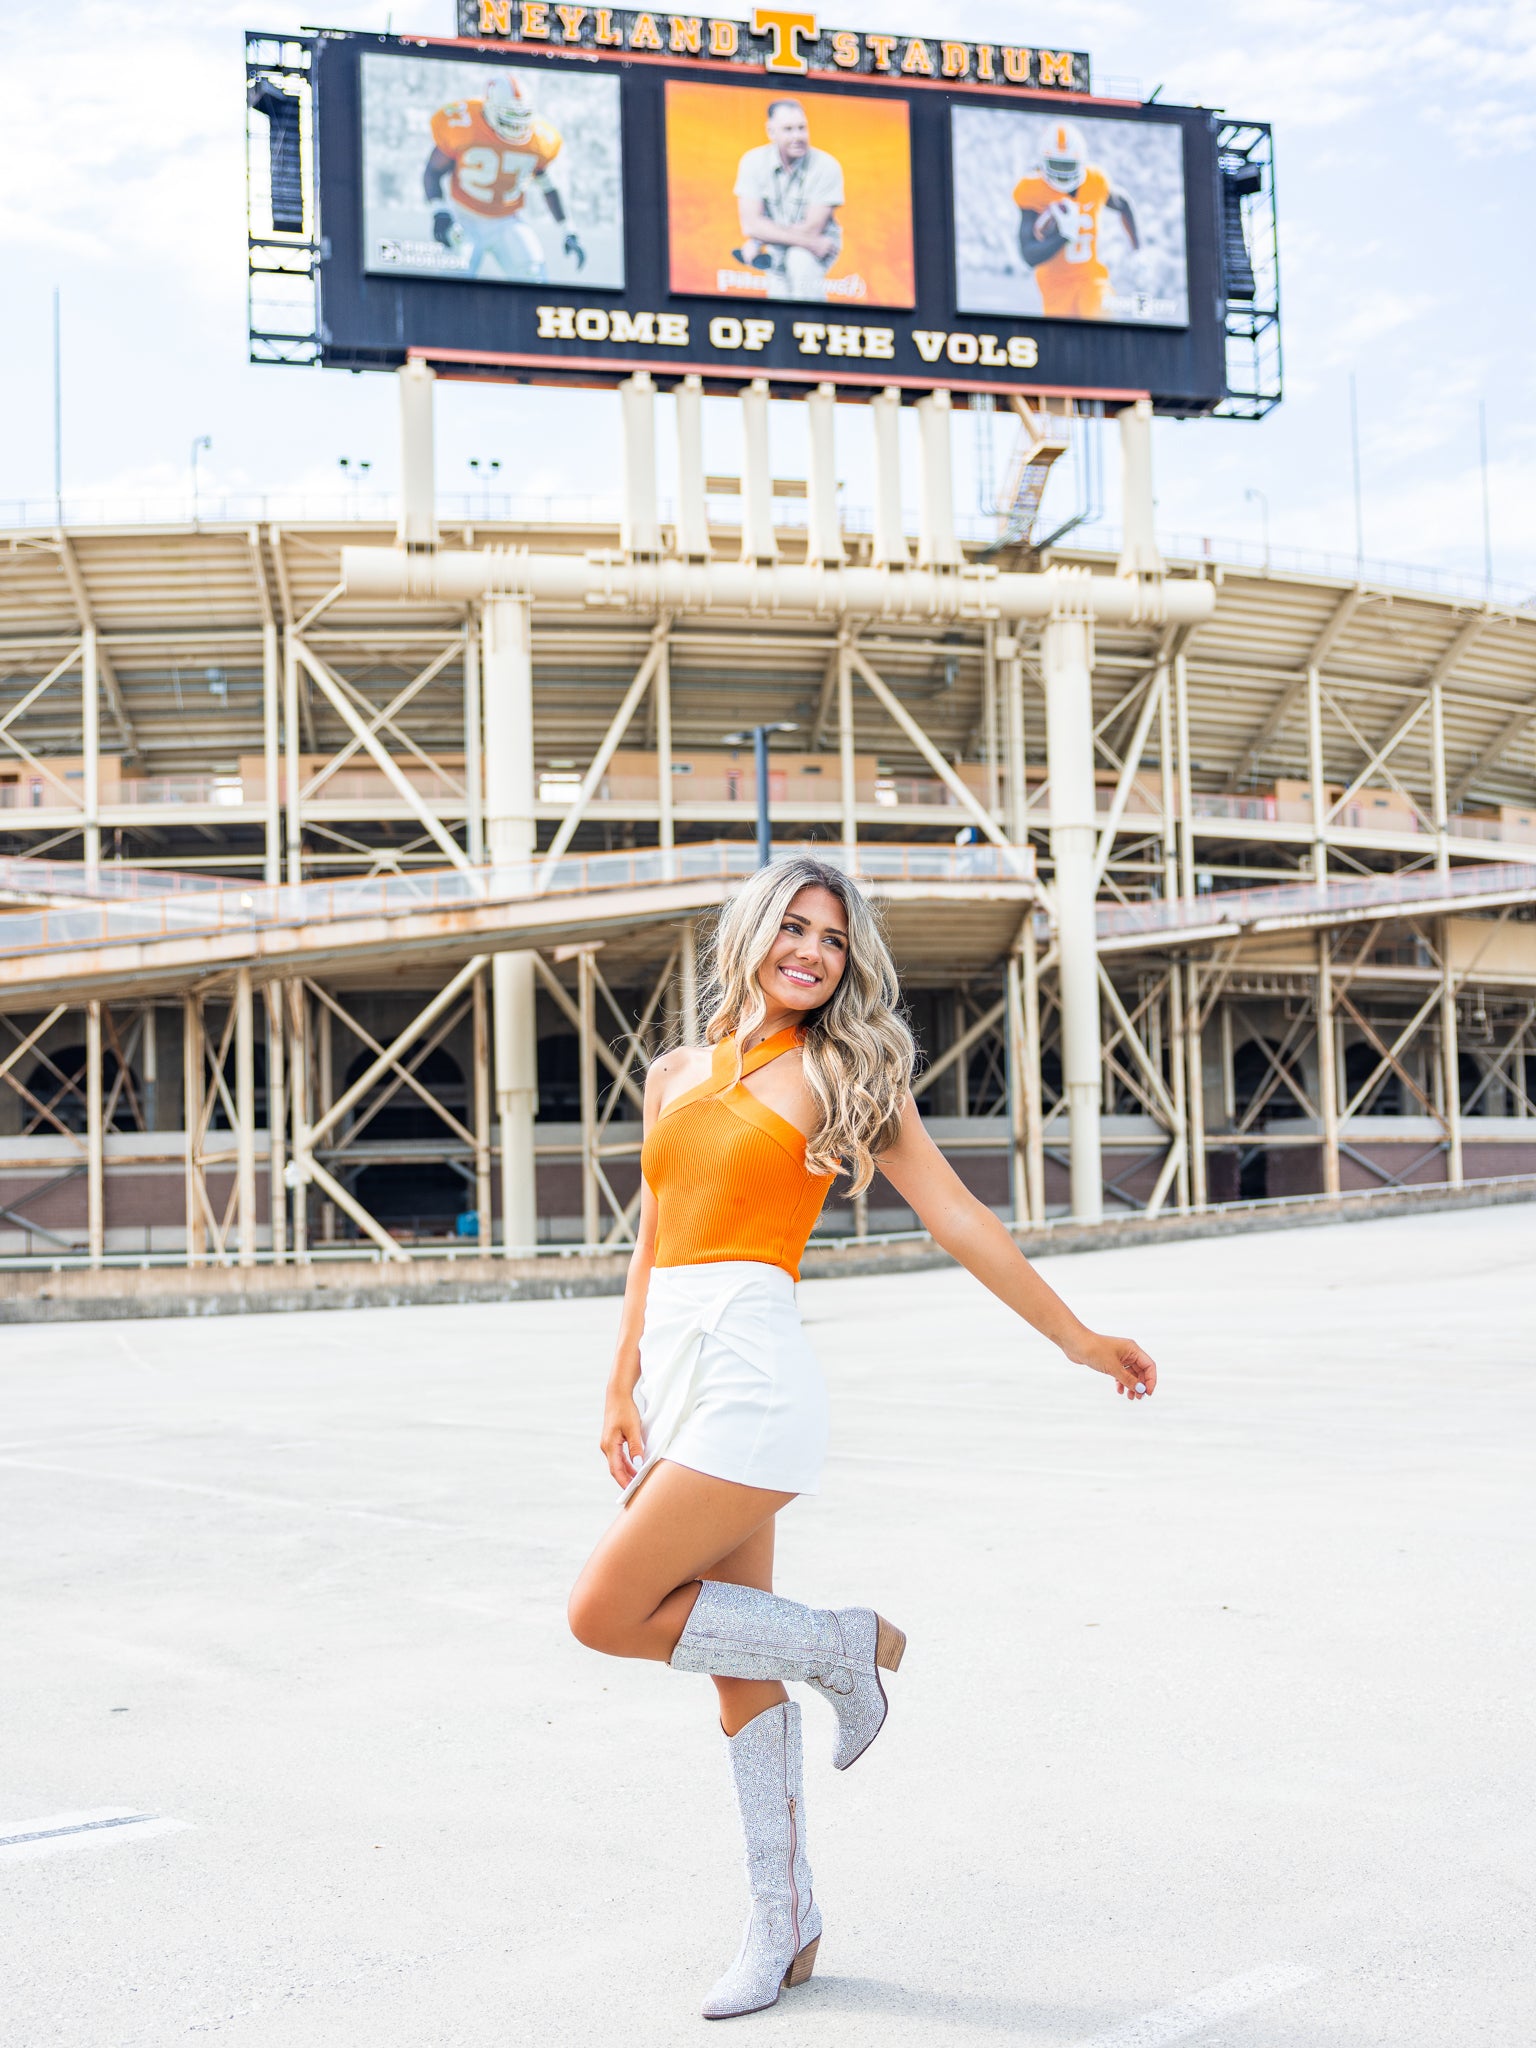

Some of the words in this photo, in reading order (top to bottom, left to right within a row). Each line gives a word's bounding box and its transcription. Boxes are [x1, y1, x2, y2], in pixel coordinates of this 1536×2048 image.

[478, 0, 738, 56] NEYLAND
[751, 8, 820, 75] T
[832, 32, 1075, 87] STADIUM
[458, 147, 538, 203] 27
[536, 306, 690, 346] HOME
[708, 317, 775, 351] OF
[793, 322, 895, 359] THE
[912, 330, 1039, 369] VOLS
